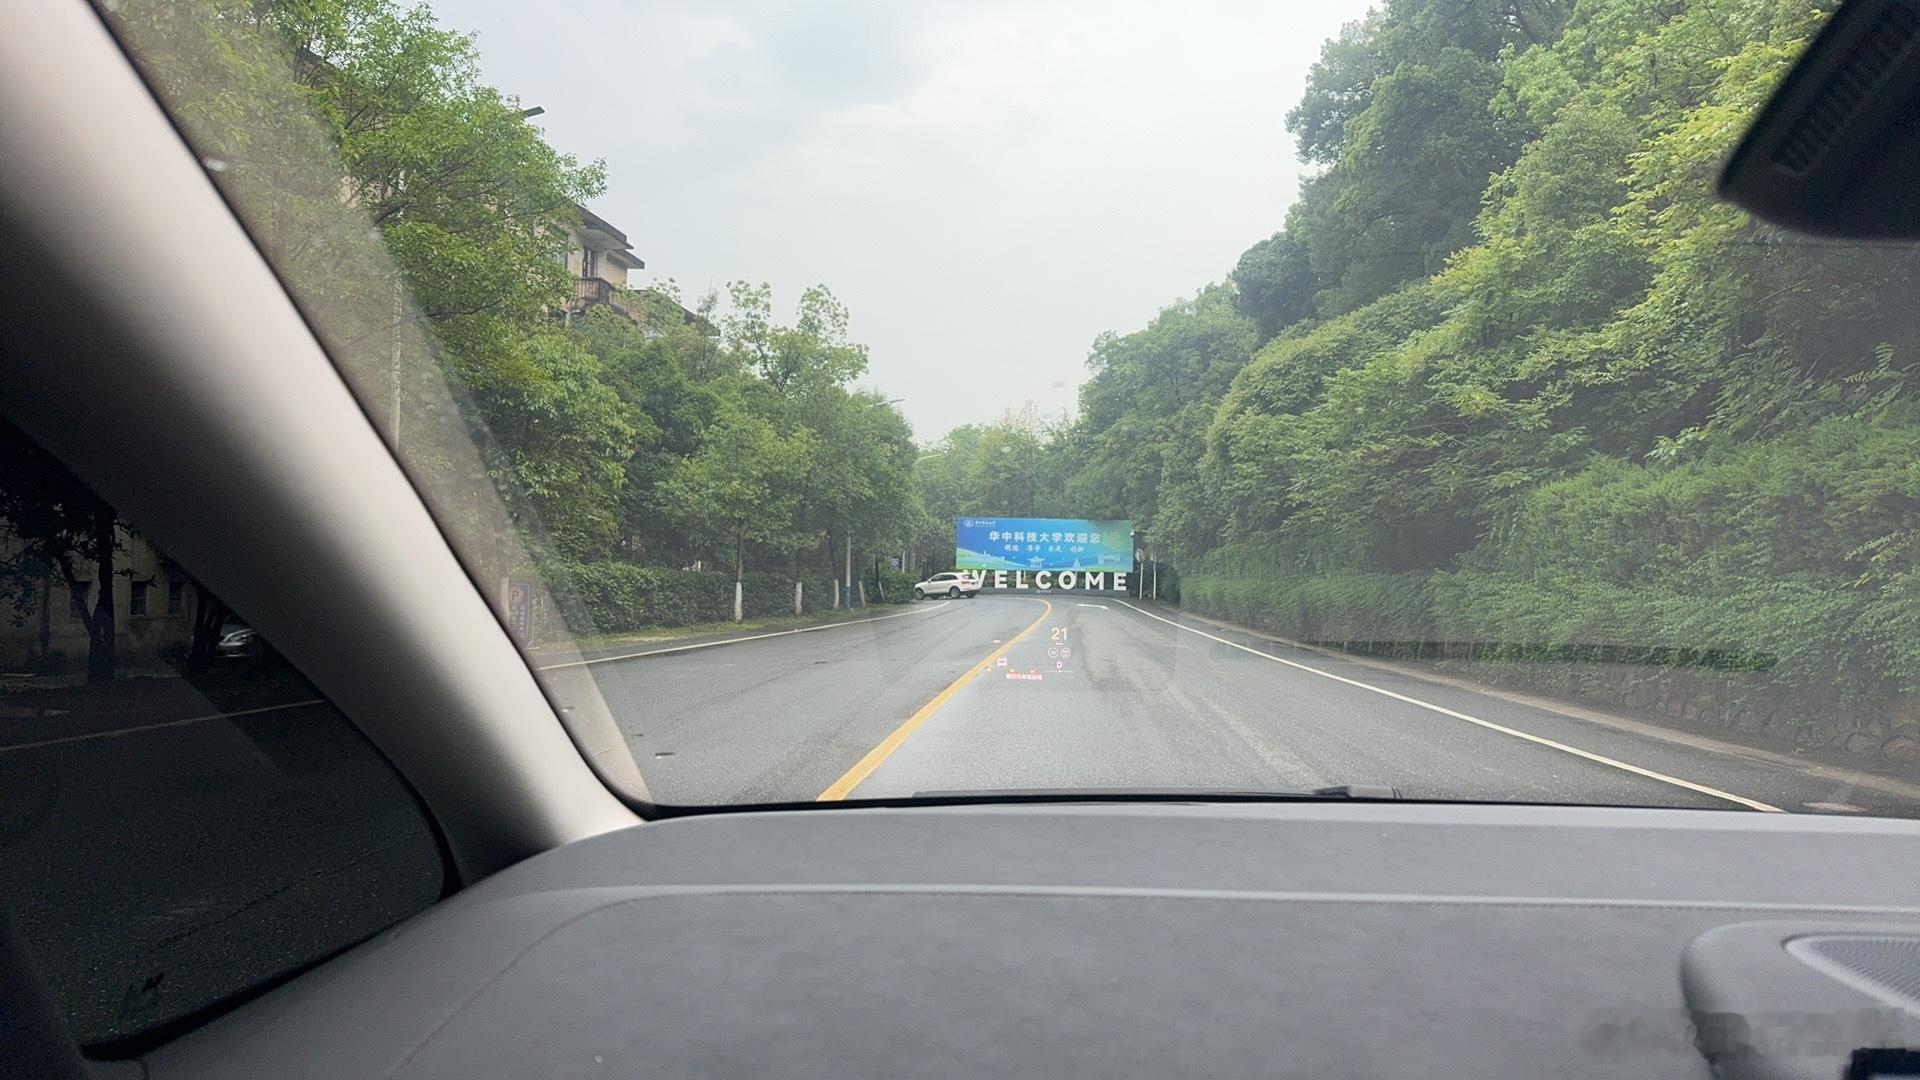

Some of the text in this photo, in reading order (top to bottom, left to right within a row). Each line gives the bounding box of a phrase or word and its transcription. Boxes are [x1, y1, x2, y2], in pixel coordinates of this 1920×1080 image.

[989, 531, 1100, 543] 华中科技大学欢迎您
[963, 569, 1127, 590] WELCOME
[512, 591, 519, 600] P
[1051, 627, 1067, 640] 21
